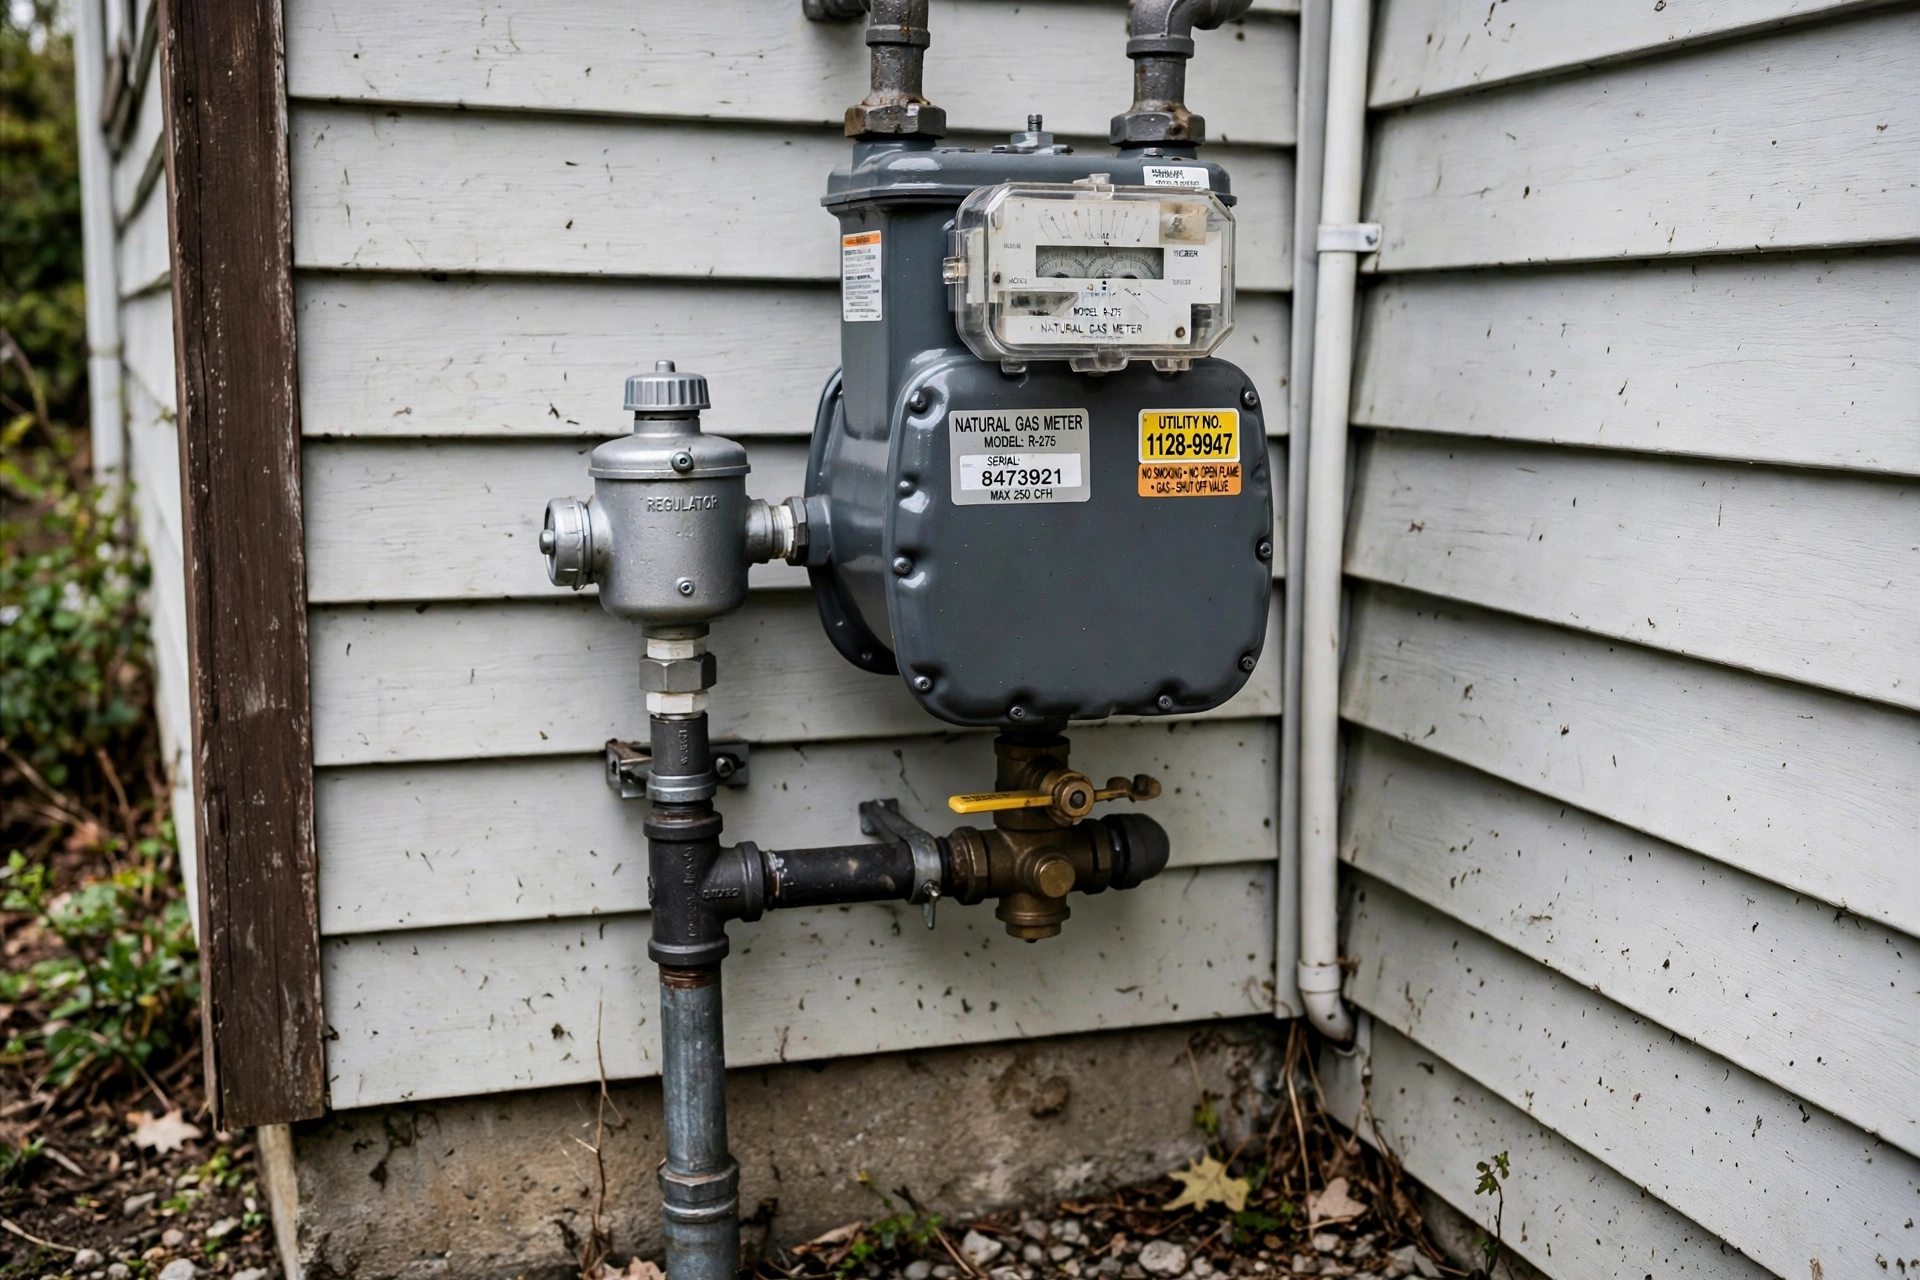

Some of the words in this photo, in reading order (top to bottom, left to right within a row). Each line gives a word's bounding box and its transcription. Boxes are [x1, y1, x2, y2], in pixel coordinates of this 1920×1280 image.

[1041, 323, 1084, 334] NATURAL
[1089, 323, 1107, 334] GAS
[1112, 323, 1143, 334] METER
[955, 417, 1010, 432] NATURAL
[1015, 416, 1040, 431] GAS
[1044, 415, 1083, 431] METER
[1158, 415, 1200, 429] UTILITY
[1202, 415, 1222, 429] NO.
[984, 436, 1024, 448] MODEL:
[1028, 435, 1056, 447] R-275
[1146, 432, 1233, 455] 1128-9947
[981, 468, 1062, 486] 8473921
[1141, 467, 1152, 479] NO
[1189, 466, 1199, 478] NO
[1201, 465, 1218, 478] OPEN
[1156, 481, 1170, 493] GAS
[1195, 480, 1208, 493] OFF
[1209, 480, 1229, 492] VALVE
[990, 490, 1010, 500] MAX
[1013, 489, 1031, 500] 250
[1034, 488, 1053, 499] CFH
[647, 495, 718, 512] REGULATOR
